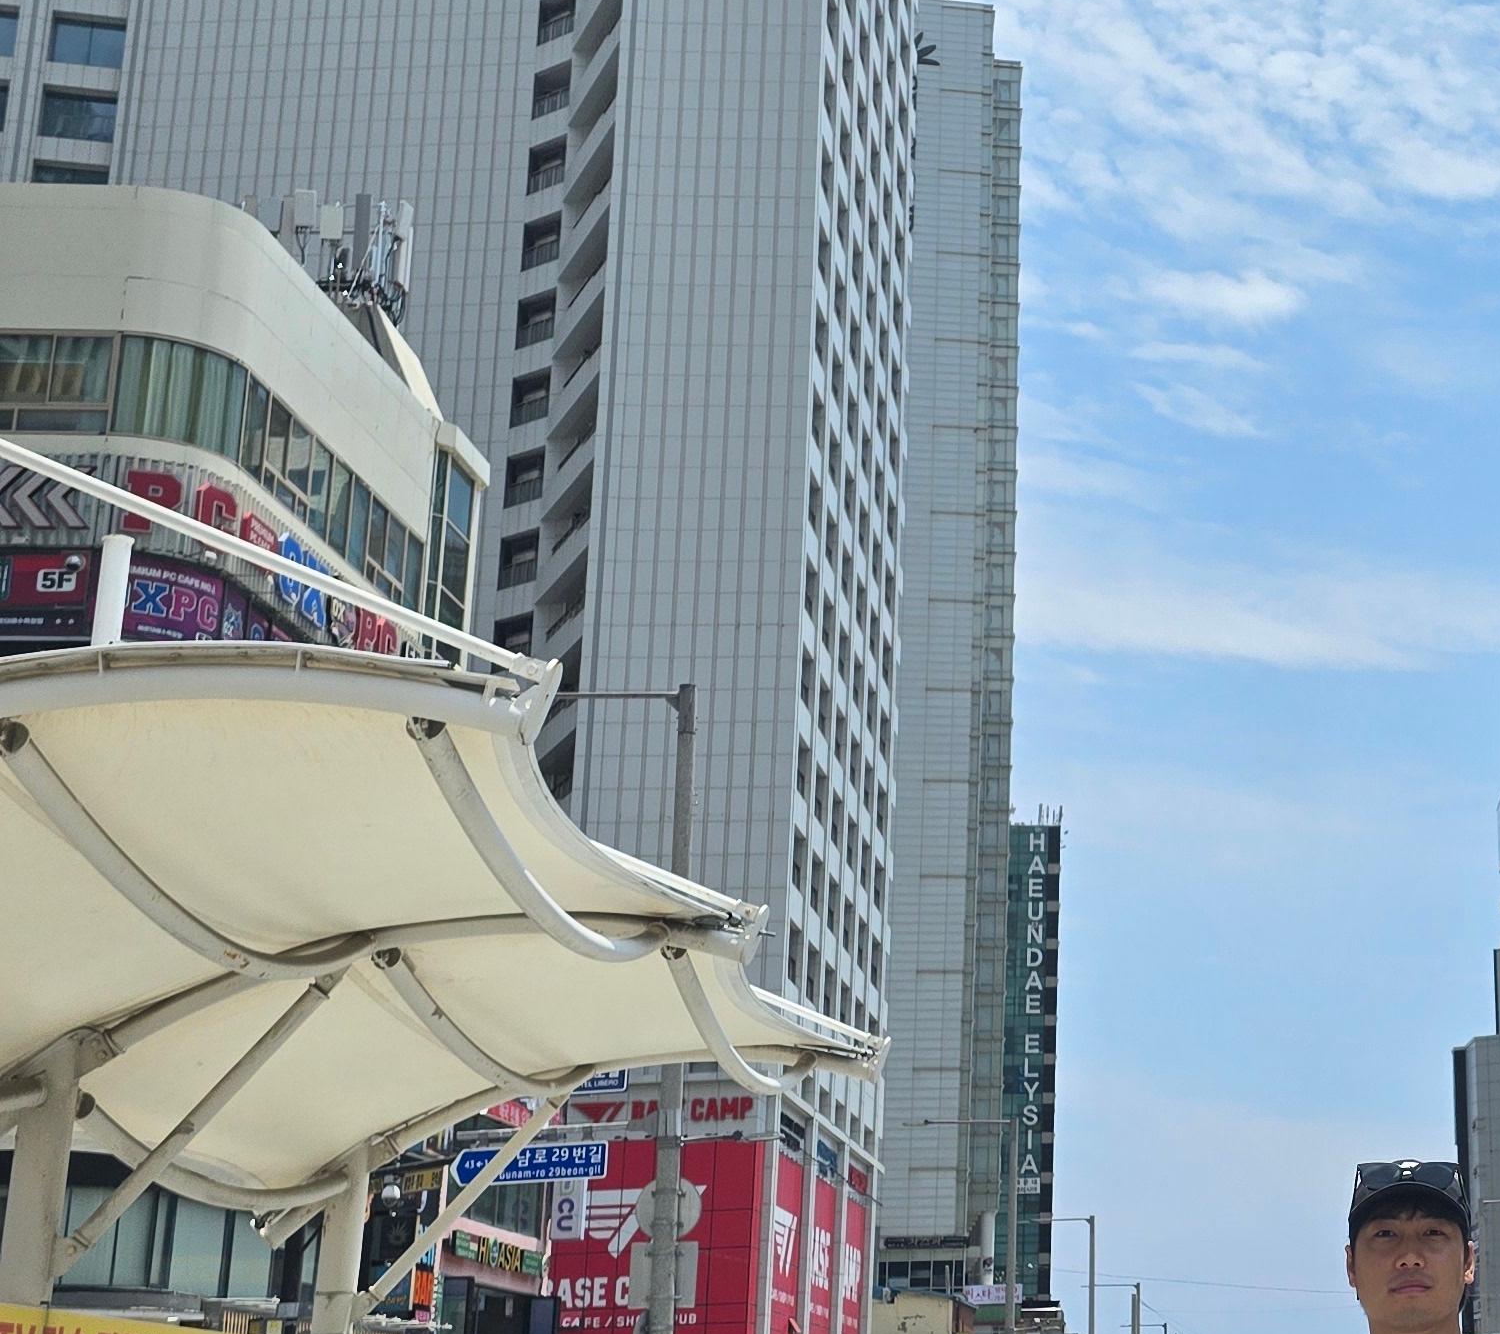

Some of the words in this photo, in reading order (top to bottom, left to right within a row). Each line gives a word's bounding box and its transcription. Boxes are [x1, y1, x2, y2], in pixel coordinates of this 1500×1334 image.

[41, 571, 73, 590] 5F
[125, 578, 219, 633] XPC
[1026, 832, 1047, 1015] HAEUNDAE
[691, 1097, 754, 1122] CAMP
[1020, 1033, 1041, 1174] ELYSIA
[497, 1241, 521, 1273] ASIA
[413, 1270, 434, 1305] BAR
[562, 1313, 603, 1328] CAFE
